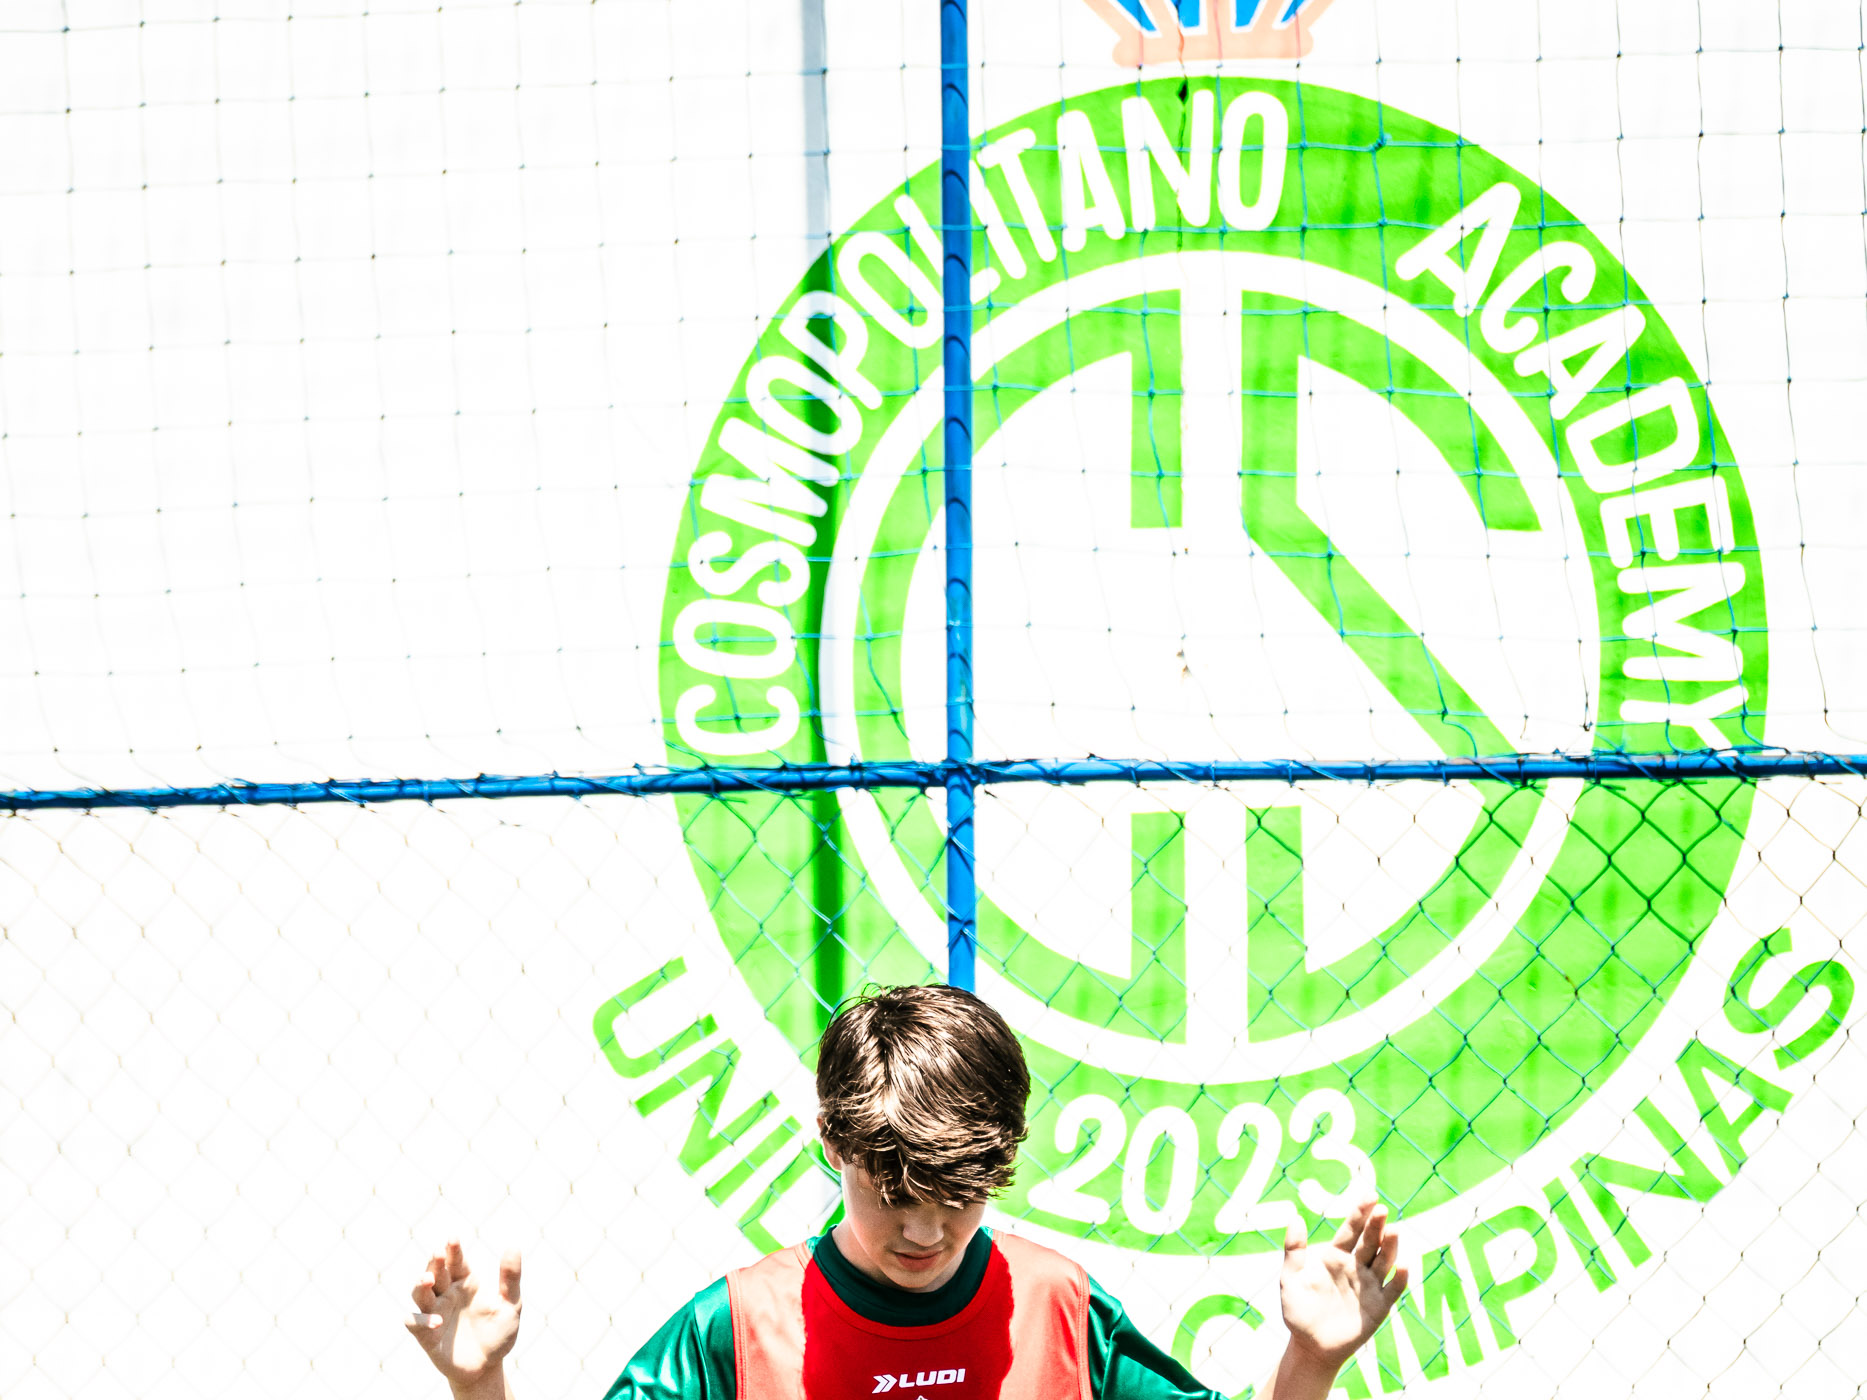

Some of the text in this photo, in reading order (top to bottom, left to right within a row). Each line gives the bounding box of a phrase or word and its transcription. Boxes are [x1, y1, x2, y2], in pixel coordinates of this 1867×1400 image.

[672, 90, 1750, 757] COSMOPOLITANO ACADEMY
[1028, 1087, 1377, 1235] 2023
[898, 1368, 966, 1388] LUDI
